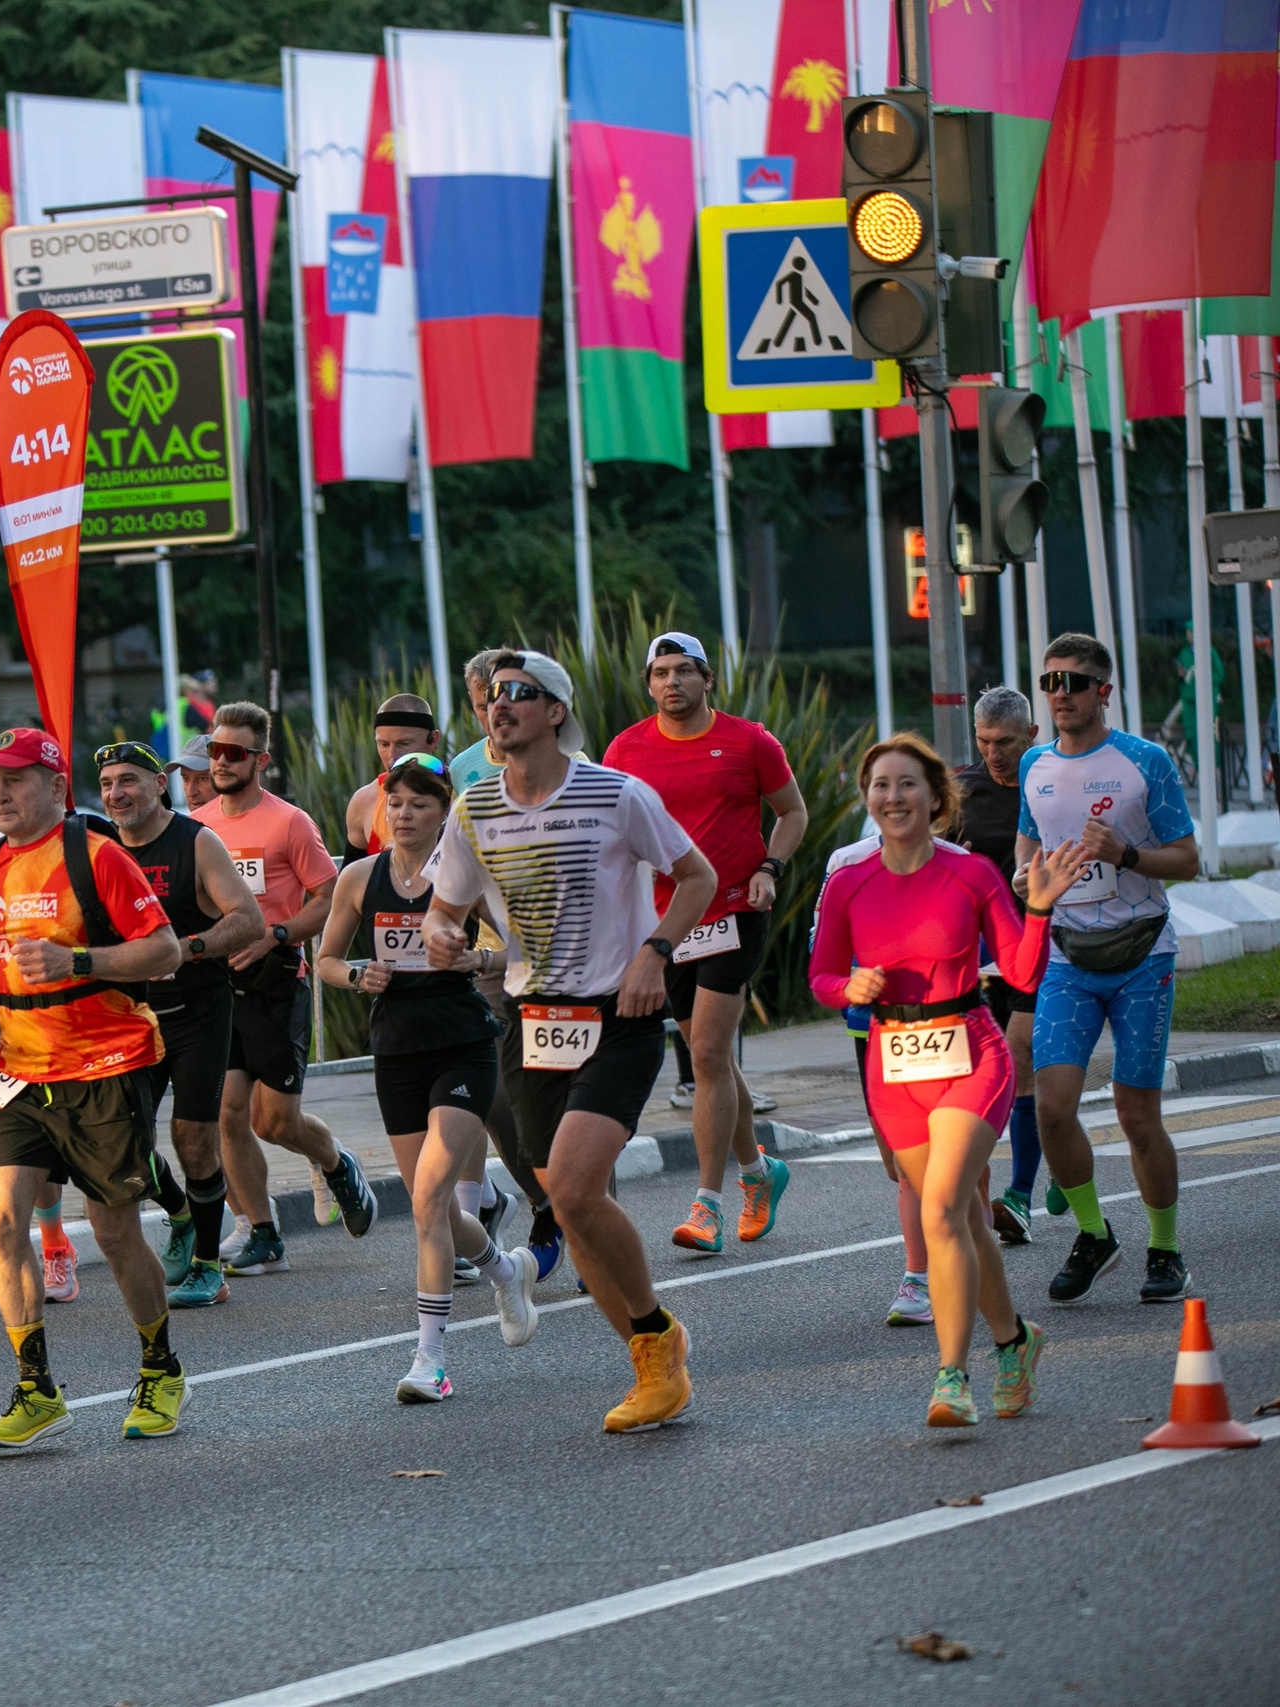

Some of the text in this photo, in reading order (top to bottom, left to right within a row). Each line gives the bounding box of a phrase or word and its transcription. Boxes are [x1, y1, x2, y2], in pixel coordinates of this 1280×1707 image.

[30, 223, 190, 258] ВОРОВСКОГО
[92, 259, 132, 276] улица
[38, 284, 146, 306] Vorovskogo st.
[34, 359, 70, 378] СОЧИ
[37, 372, 72, 386] МАРАФОН
[10, 423, 70, 466] 4:14
[85, 464, 226, 488] едвижимость
[13, 505, 63, 527] 6:01 мин/км
[82, 509, 207, 536] 00 201-03-03
[19, 549, 45, 567] 42.2
[1083, 781, 1122, 791] LABVITA
[235, 861, 257, 877] 35
[8, 910, 58, 920] МАРАФОН
[9, 899, 58, 913] СОЧИ
[1151, 993, 1168, 1052] LABVITA
[535, 1026, 589, 1050] 6641
[890, 1029, 956, 1056] 6347
